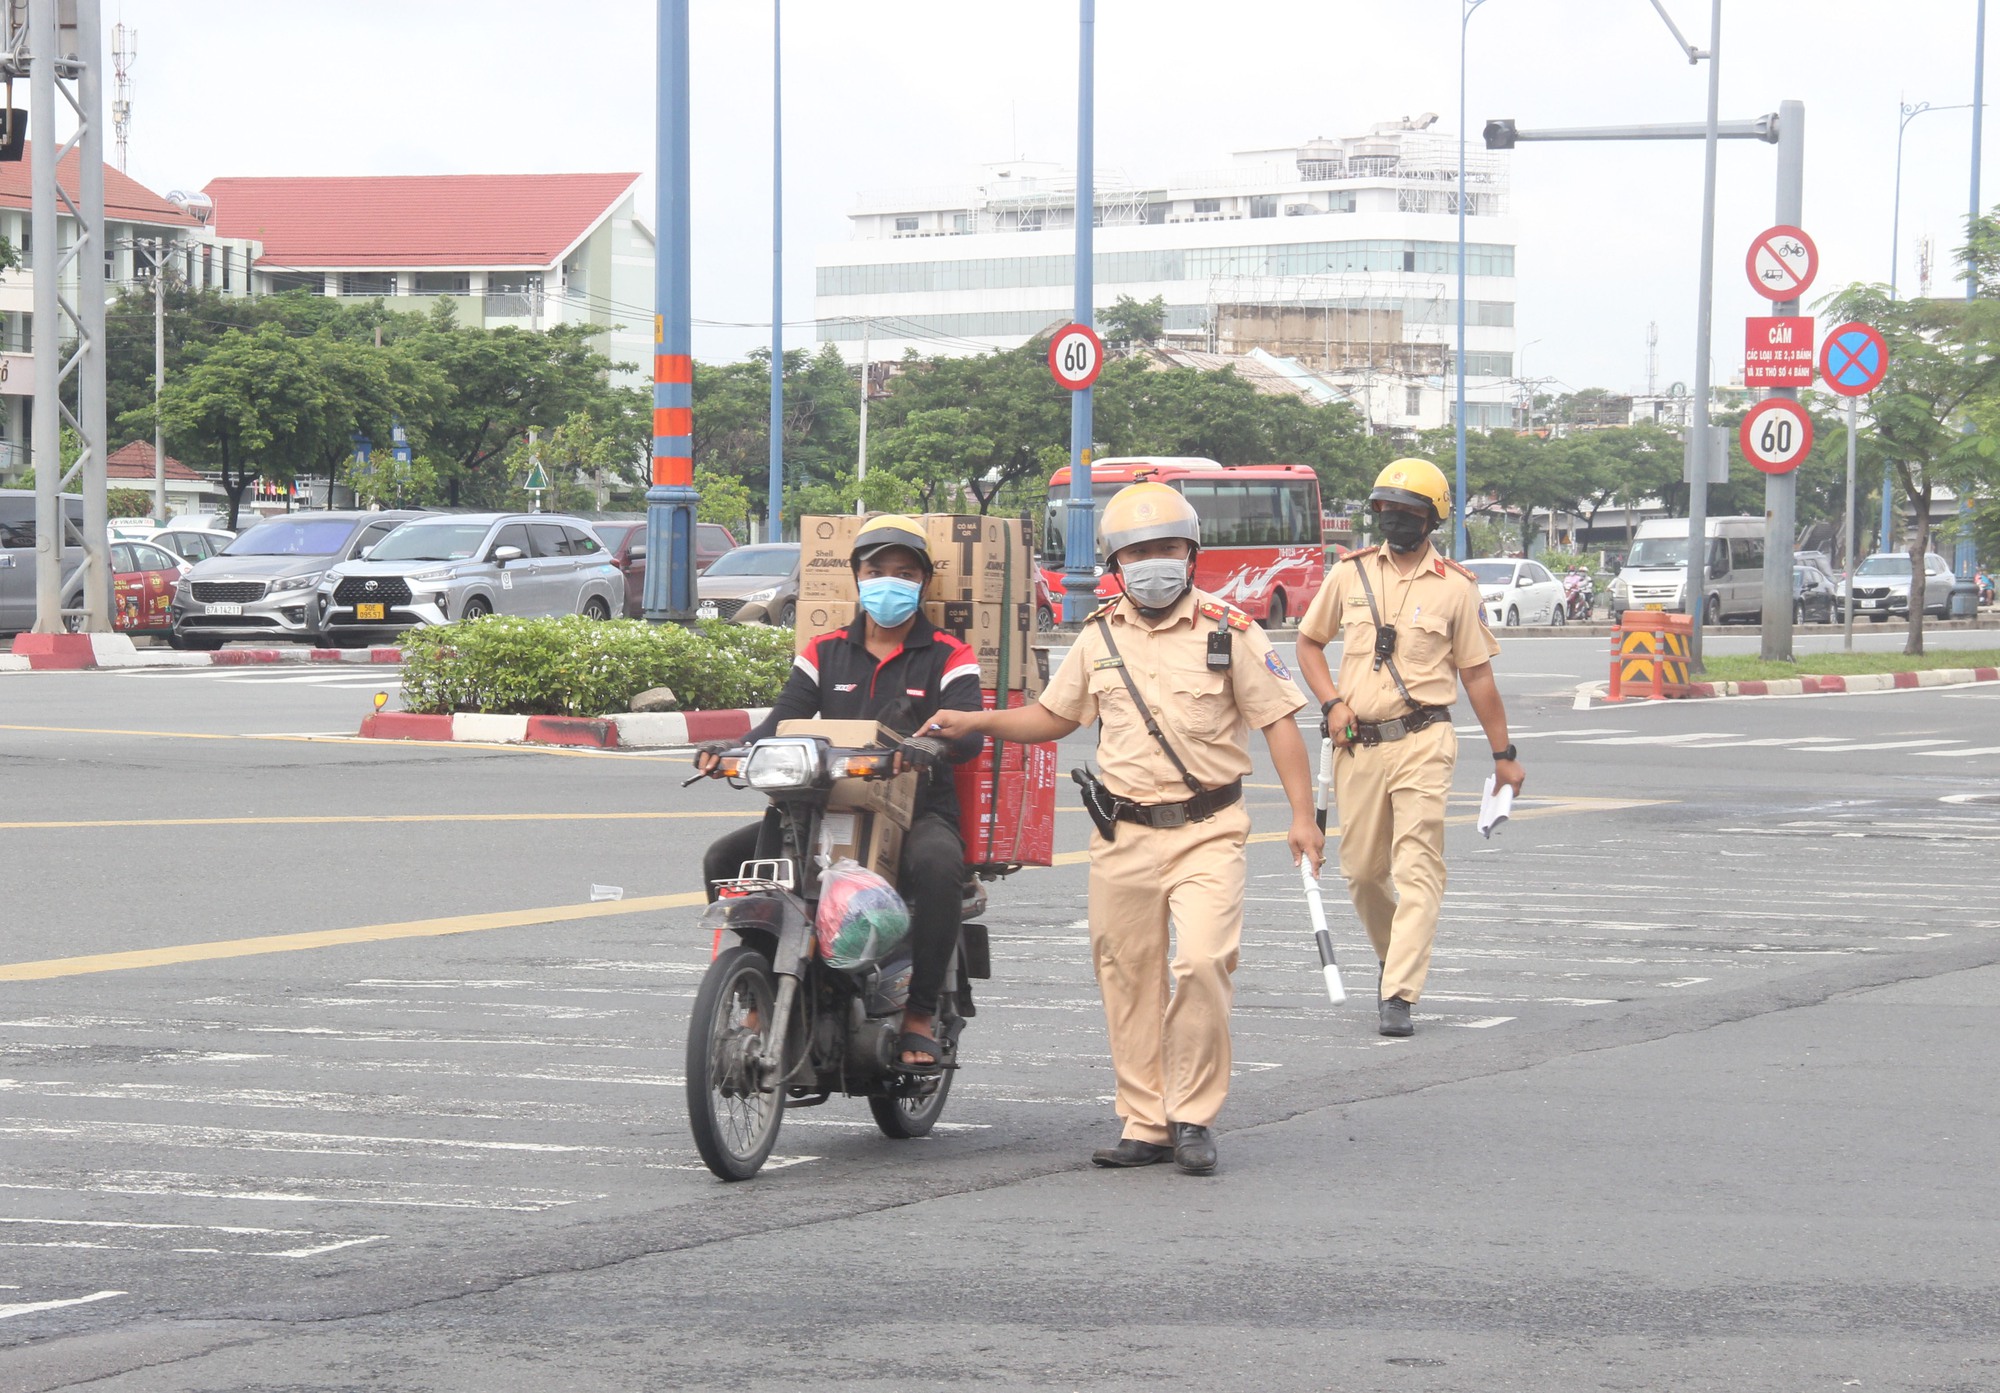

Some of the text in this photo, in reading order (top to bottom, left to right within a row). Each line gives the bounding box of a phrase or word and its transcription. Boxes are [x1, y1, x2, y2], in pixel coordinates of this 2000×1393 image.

[1768, 322, 1792, 344] CẤM
[1064, 342, 1087, 371] 60
[1746, 348, 1812, 363] CÁC LOẠI XE 2,3 BÁNH
[0, 360, 9, 381] Ổ
[1747, 364, 1754, 377] VÀ
[1755, 367, 1763, 377] XE
[1788, 367, 1792, 377] 4
[1794, 365, 1810, 377] BÁNH
[1761, 420, 1792, 453] 60
[806, 558, 851, 568] ADVANC
